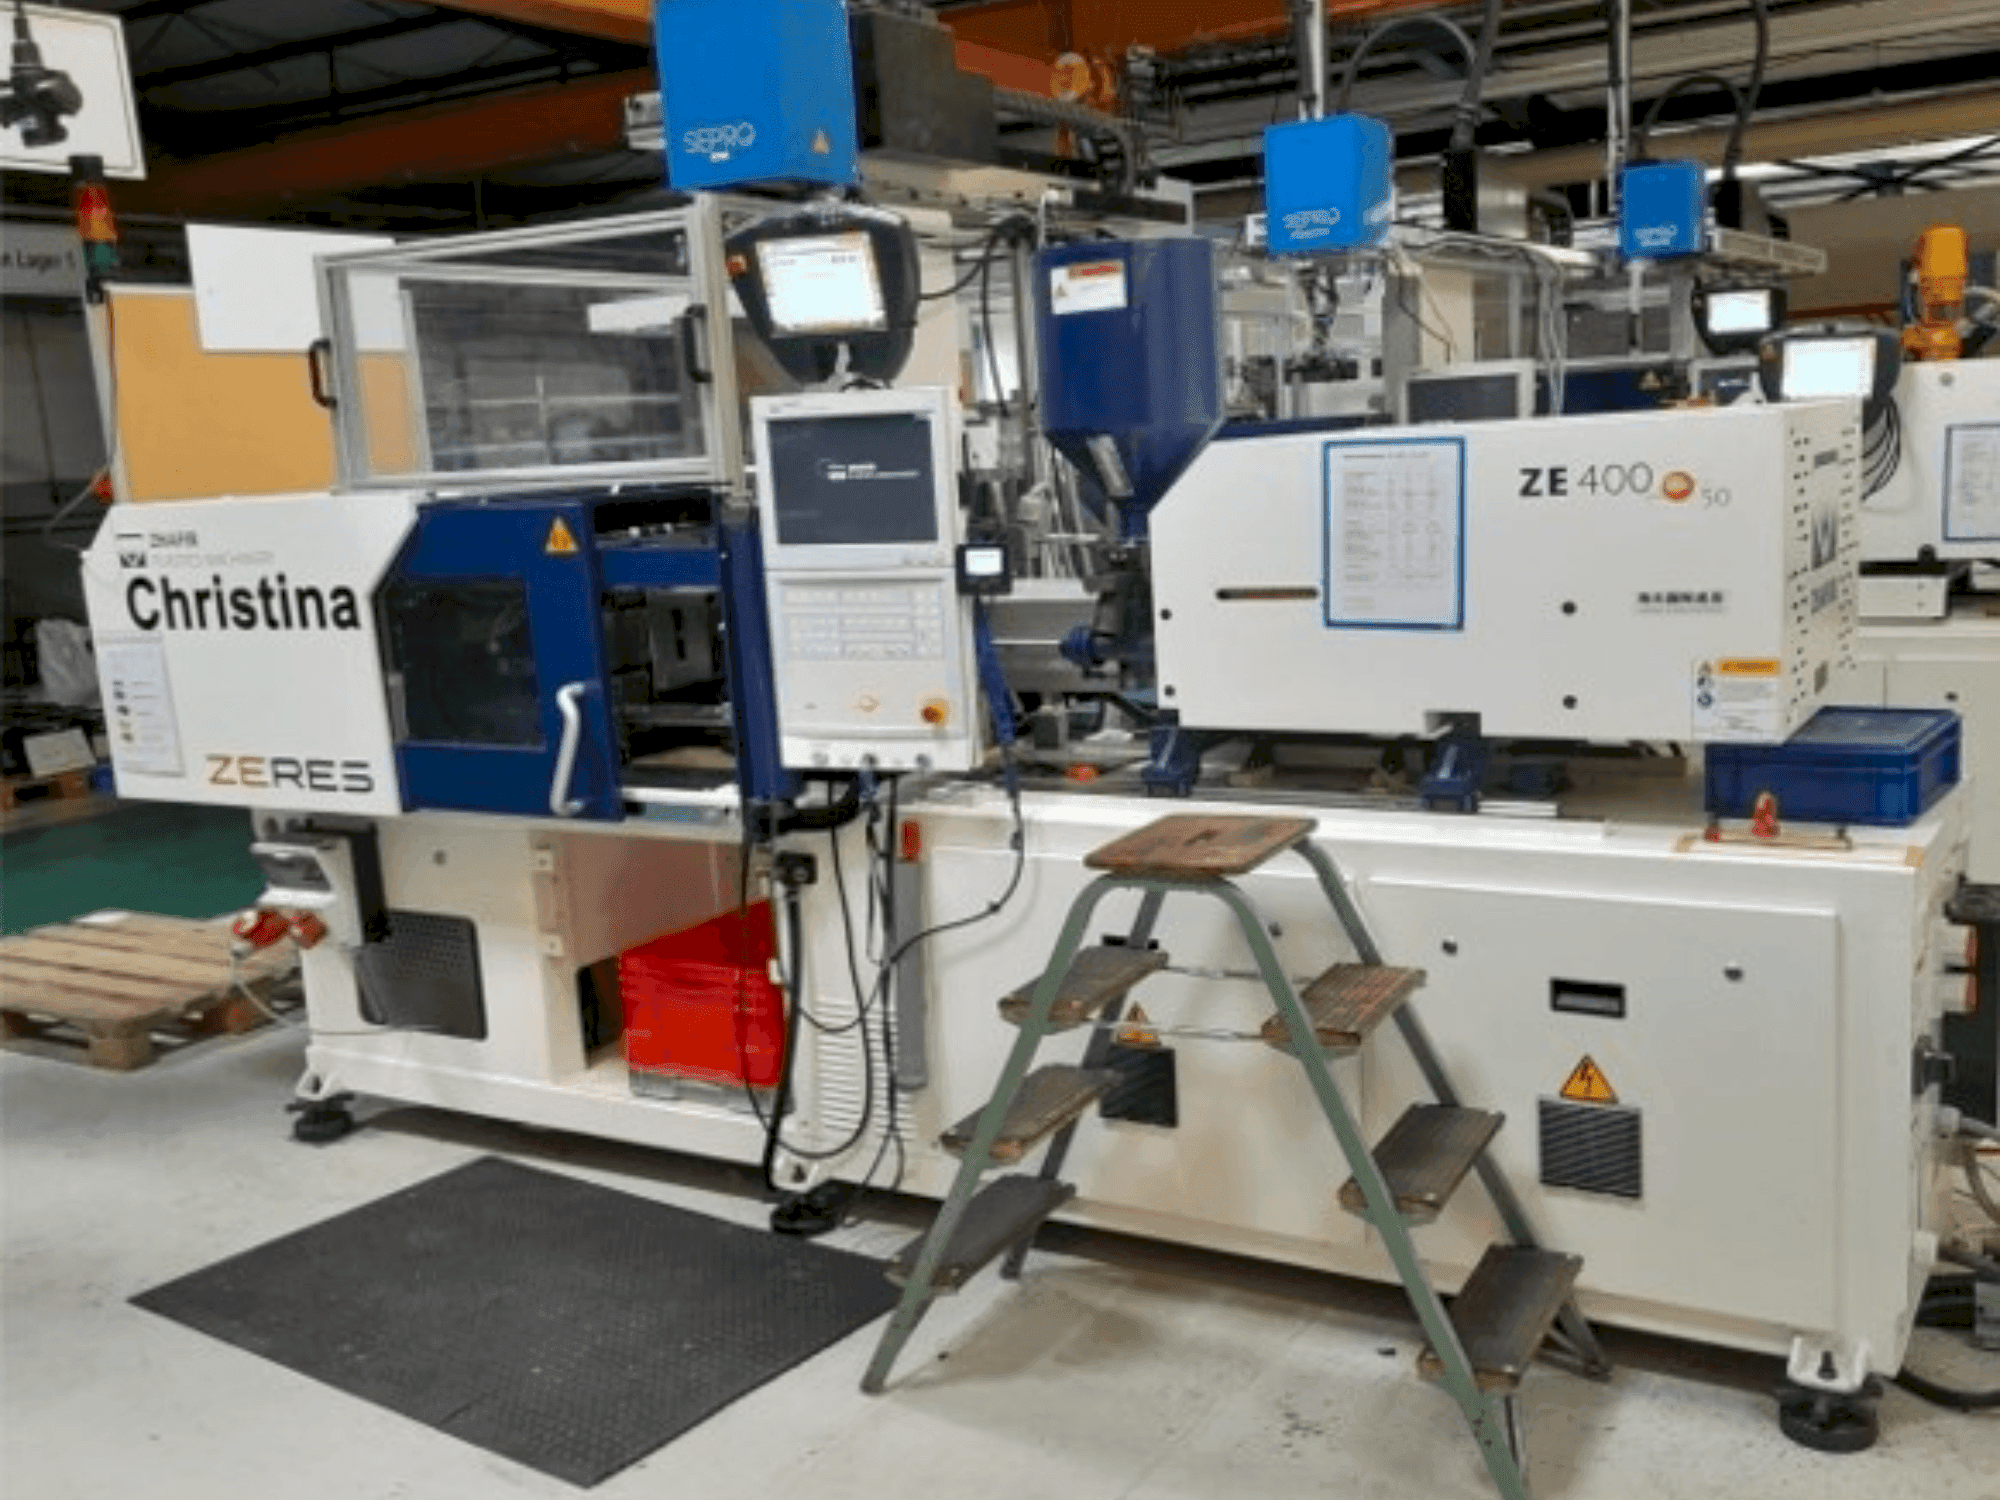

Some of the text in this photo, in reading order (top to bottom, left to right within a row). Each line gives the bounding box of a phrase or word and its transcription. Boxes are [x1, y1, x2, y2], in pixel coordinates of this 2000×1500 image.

[683, 122, 757, 153] SEPRO
[1518, 461, 1733, 510] ZE 400 50
[125, 572, 362, 631] Christina
[205, 754, 375, 793] ZERES
